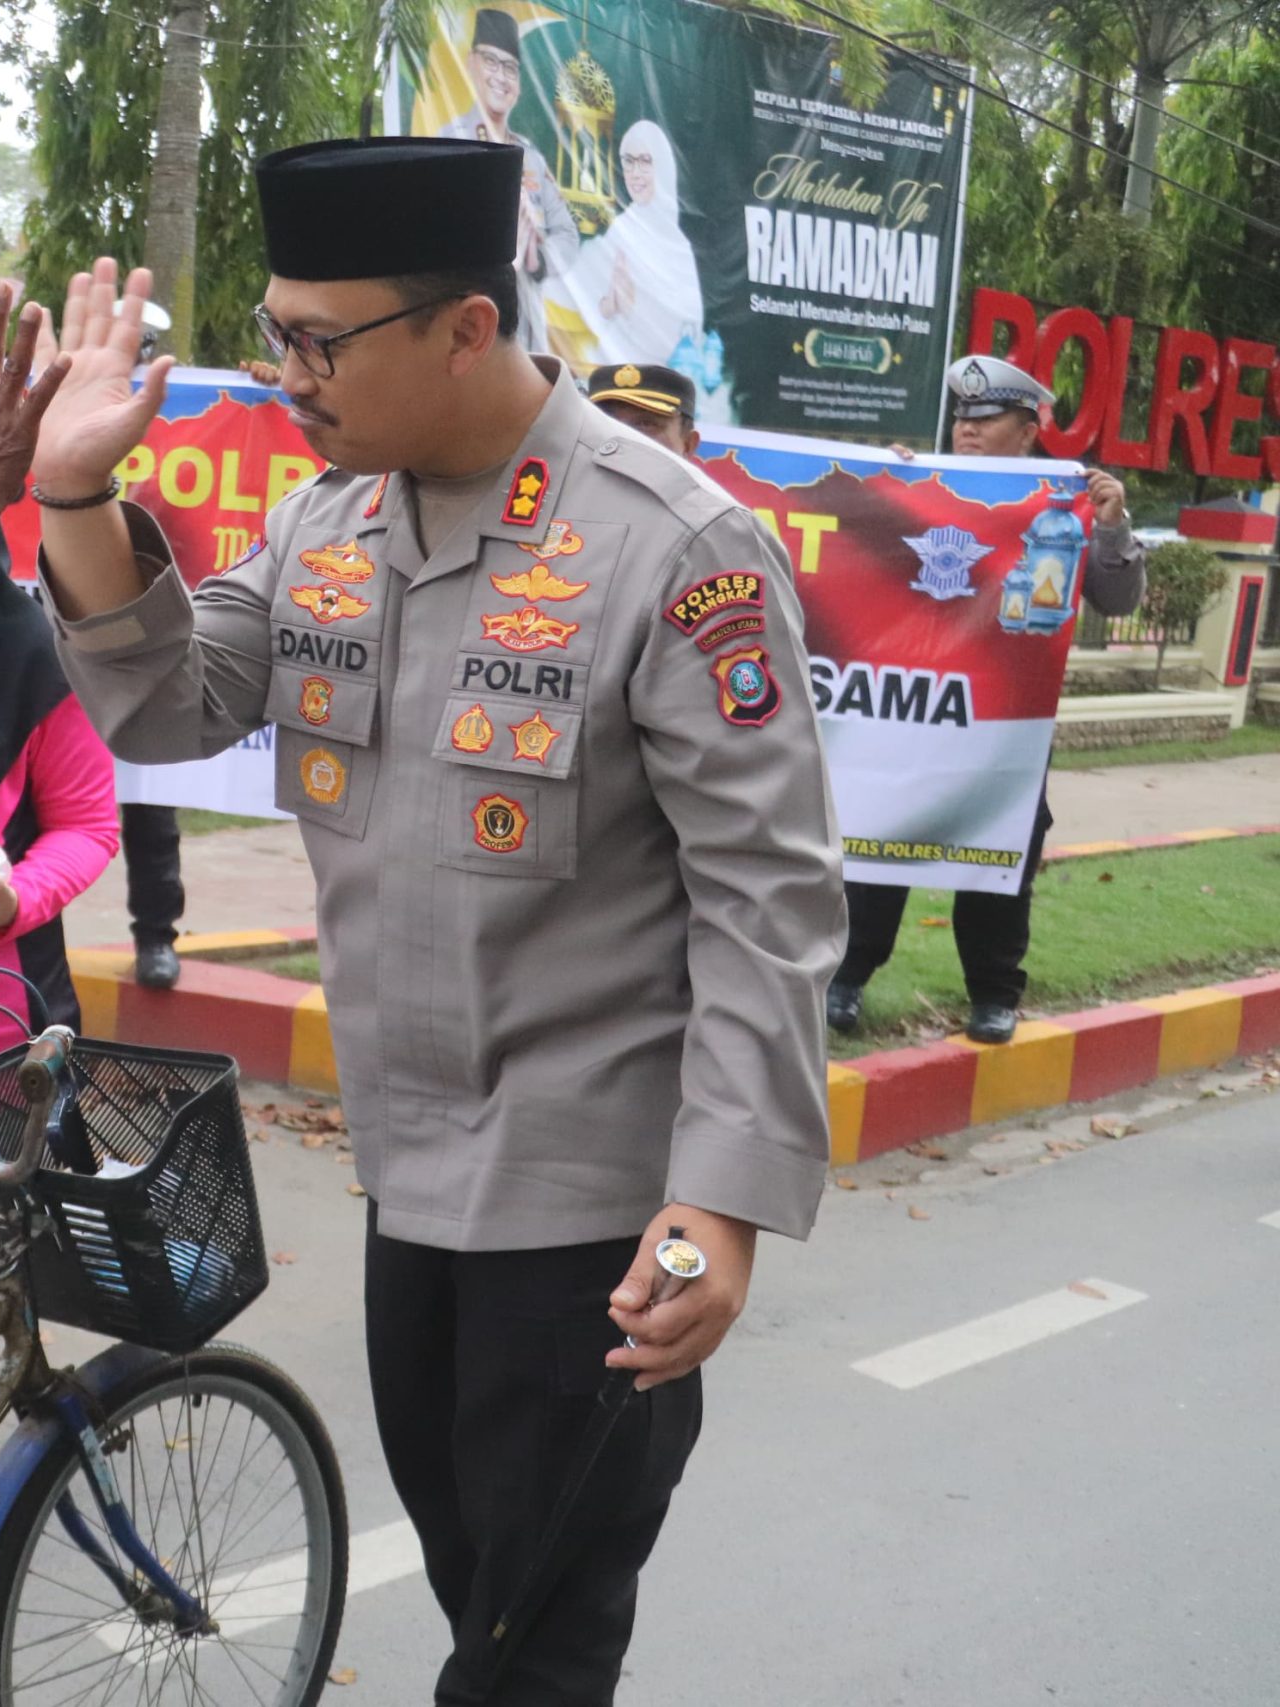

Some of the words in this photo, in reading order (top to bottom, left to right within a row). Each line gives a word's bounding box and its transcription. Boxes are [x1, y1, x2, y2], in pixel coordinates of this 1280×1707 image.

[753, 154, 883, 215] Marhaban
[882, 179, 943, 230] Ya
[745, 205, 939, 308] RAMADHAN
[750, 293, 799, 318] Selamat
[673, 575, 758, 621] POLRES
[689, 588, 752, 621] LANGKAT
[279, 628, 368, 672] DAVID
[462, 657, 573, 700] POLRI
[882, 841, 944, 861] POLRES
[945, 846, 1022, 868] LANGKAT
